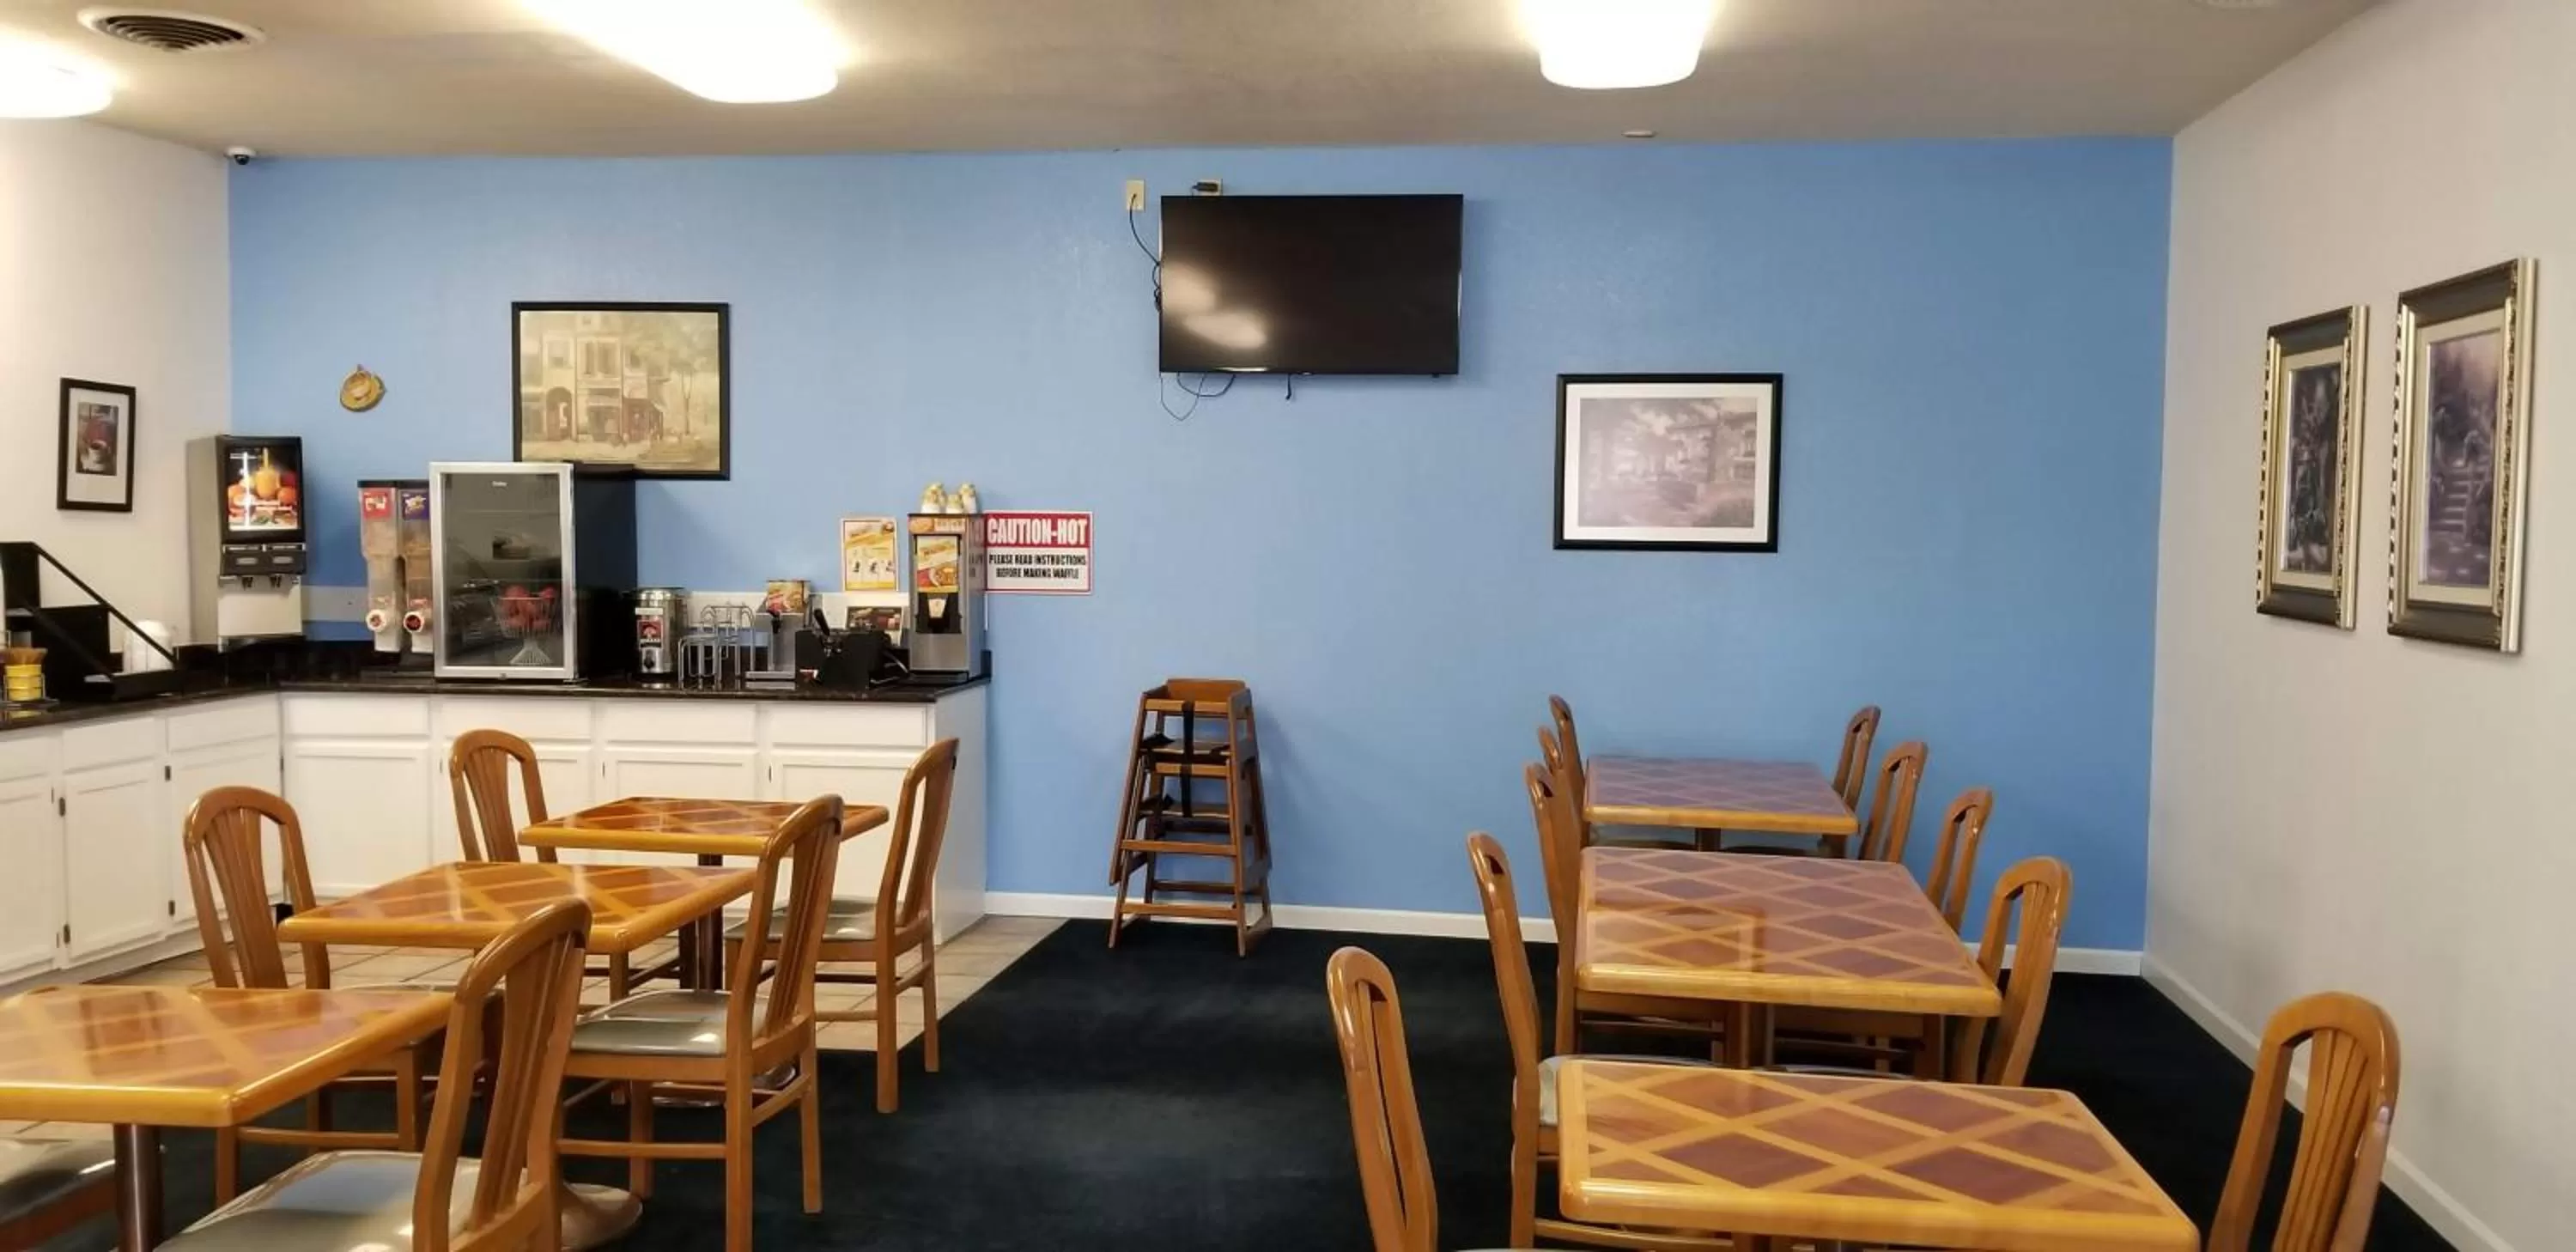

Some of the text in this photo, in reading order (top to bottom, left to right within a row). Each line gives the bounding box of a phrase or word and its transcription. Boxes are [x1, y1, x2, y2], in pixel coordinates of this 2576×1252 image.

[987, 518, 1087, 545] CAUTION-HOT
[988, 554, 1086, 565] PLEASE READ INSTRUCTIONS
[996, 568, 1079, 579] BEFORE MAKING WAFFLE
